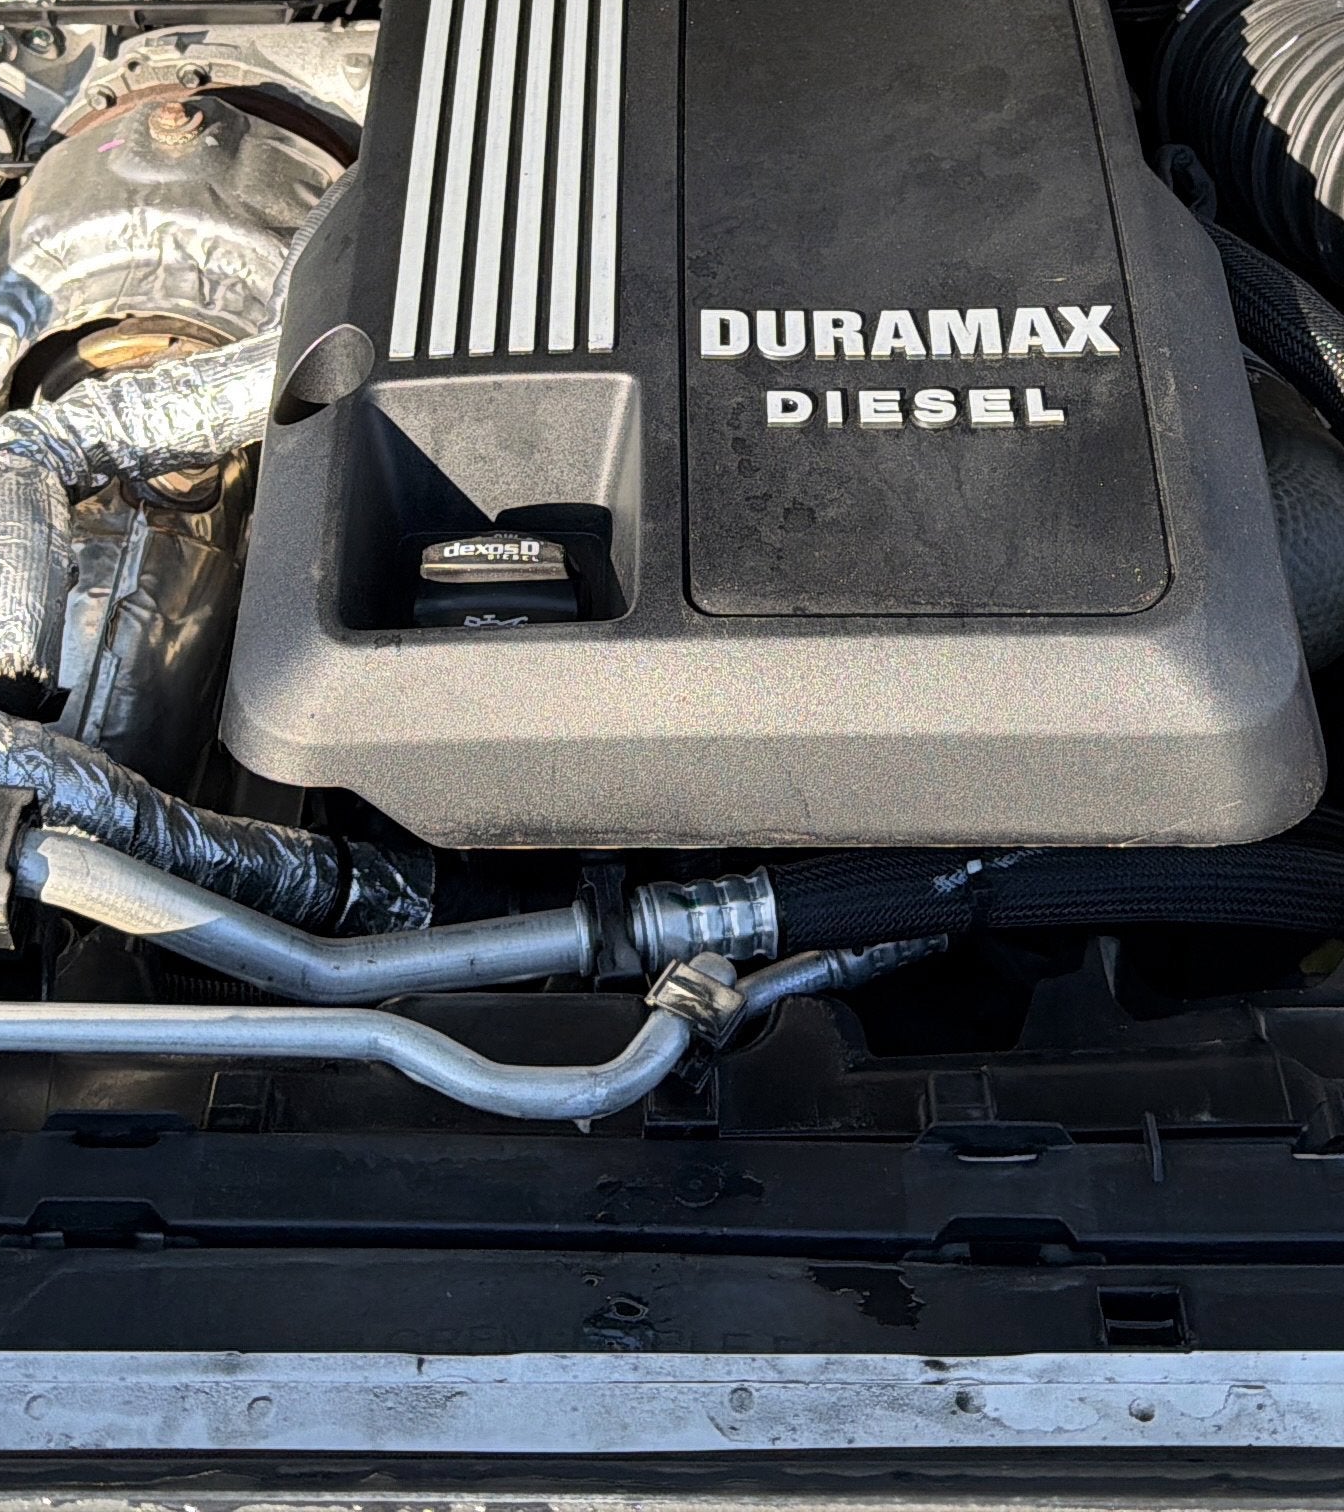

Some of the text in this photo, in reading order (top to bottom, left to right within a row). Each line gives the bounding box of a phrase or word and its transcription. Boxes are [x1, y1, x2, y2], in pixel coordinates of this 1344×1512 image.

[700, 305, 1120, 359] DURAMAX
[767, 388, 1065, 428] DIESEL
[487, 554, 539, 562] DIESEL
